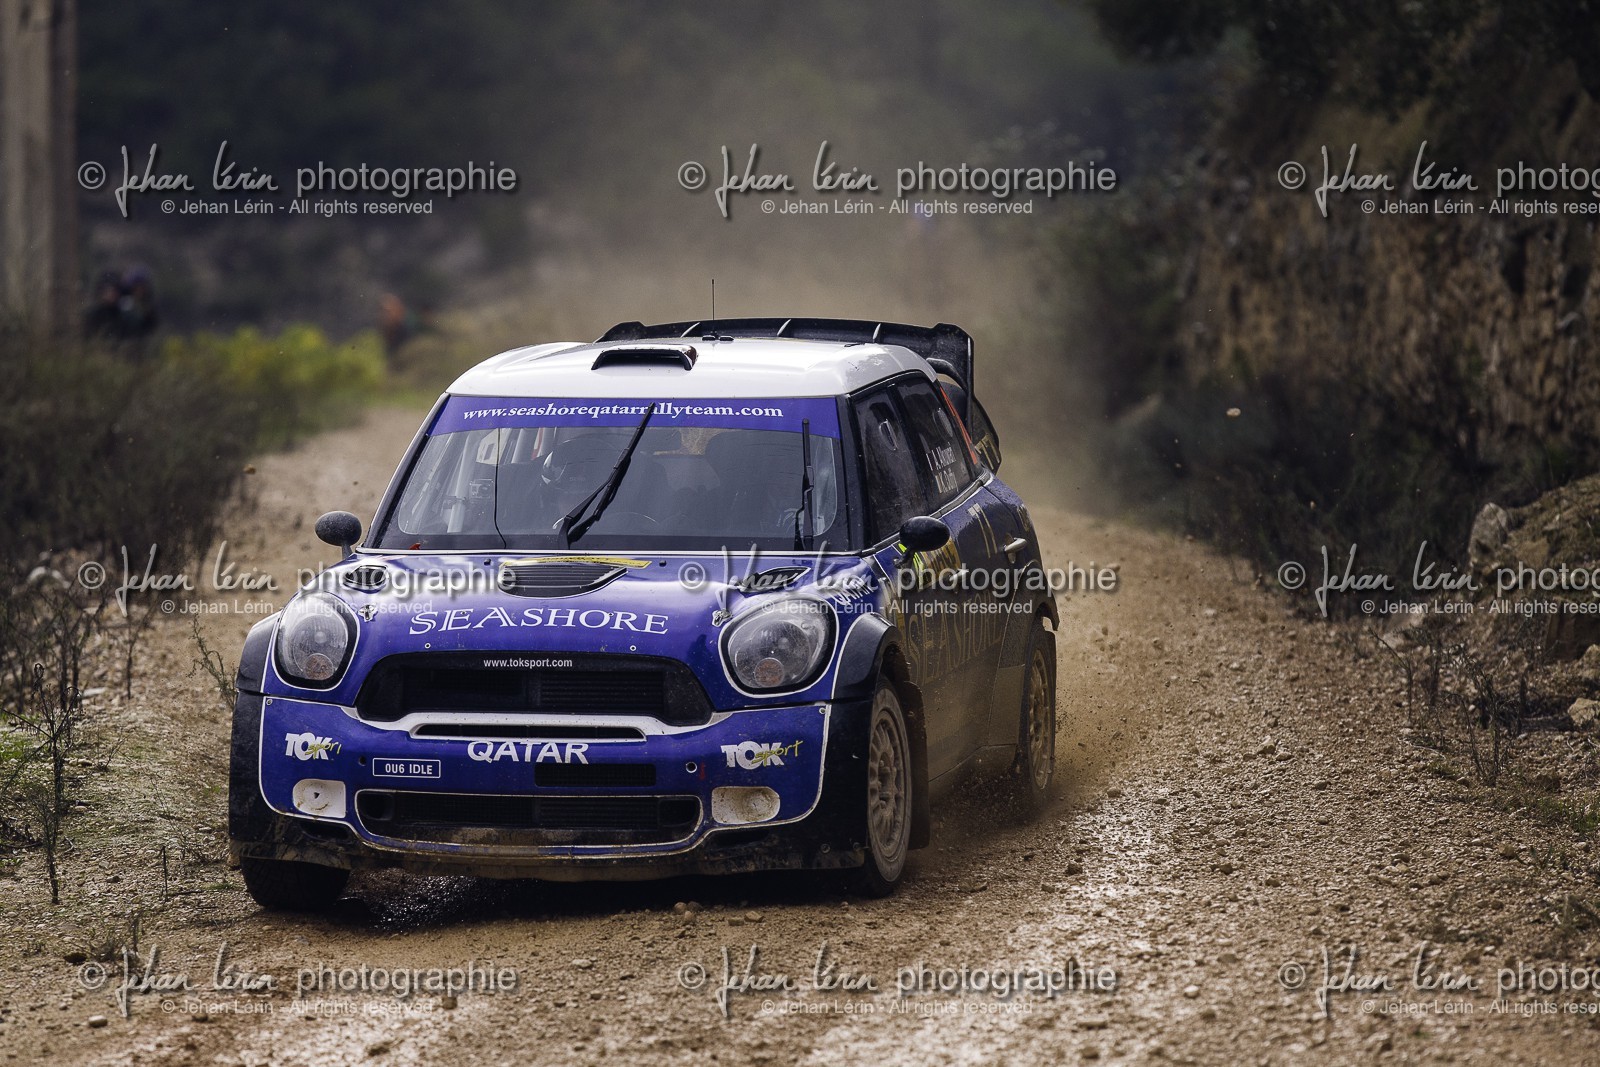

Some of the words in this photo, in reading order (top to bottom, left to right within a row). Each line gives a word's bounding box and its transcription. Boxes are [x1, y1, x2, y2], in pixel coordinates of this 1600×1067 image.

[409, 606, 669, 635] SEASHORE
[483, 658, 573, 669] www.toksport.com
[467, 741, 589, 765] QATAR
